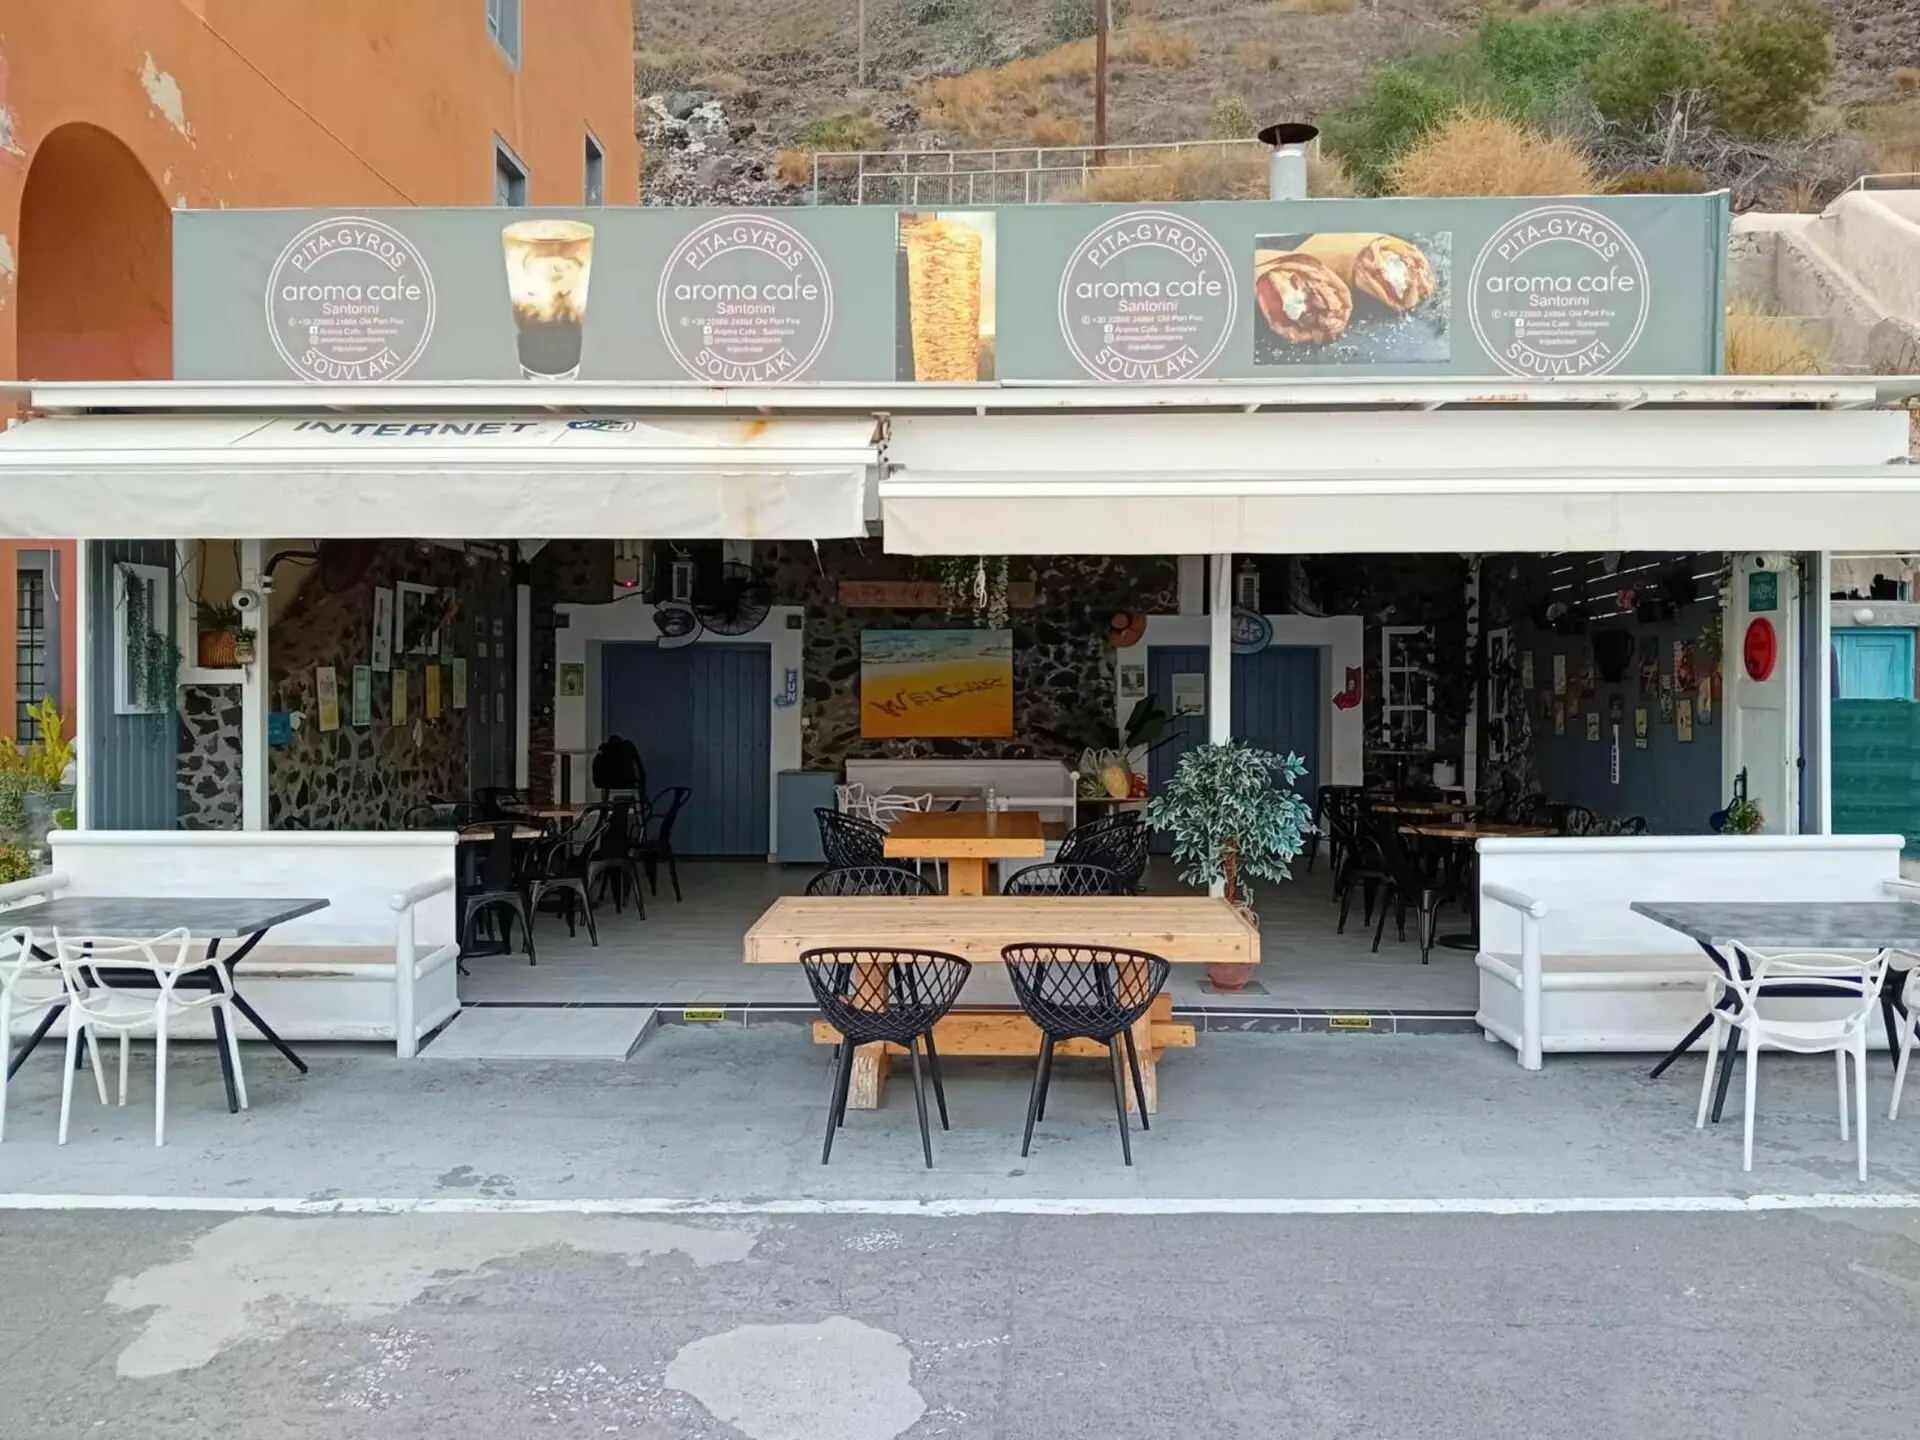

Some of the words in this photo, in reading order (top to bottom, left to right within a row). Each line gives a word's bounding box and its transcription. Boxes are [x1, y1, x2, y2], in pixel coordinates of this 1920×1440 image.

[291, 228, 407, 271] PITA-GYROS
[685, 227, 803, 269] PITA-GYROS
[1087, 223, 1208, 266] PITA-GYROS
[1497, 218, 1620, 261] PITA-GYROS
[282, 285, 361, 301] aroma
[367, 276, 422, 301] cafe
[674, 284, 758, 301] aroma
[762, 274, 818, 301] cafe
[1075, 280, 1160, 299] aroma
[1166, 270, 1222, 298] cafe
[1486, 275, 1571, 292] aroma
[1577, 265, 1635, 292] cafe
[322, 302, 379, 315] Santorini
[716, 301, 775, 315] Santorini
[1118, 299, 1178, 313] Santorini
[1528, 294, 1589, 307] Santorini
[301, 349, 401, 381] SOUVLAKI
[695, 349, 797, 382] SOUVLAKI
[1095, 347, 1200, 380] SOUVLAKI
[1506, 341, 1611, 374] SOUVLAKI
[291, 420, 540, 437] INTERNET
[786, 672, 796, 702] FUN
